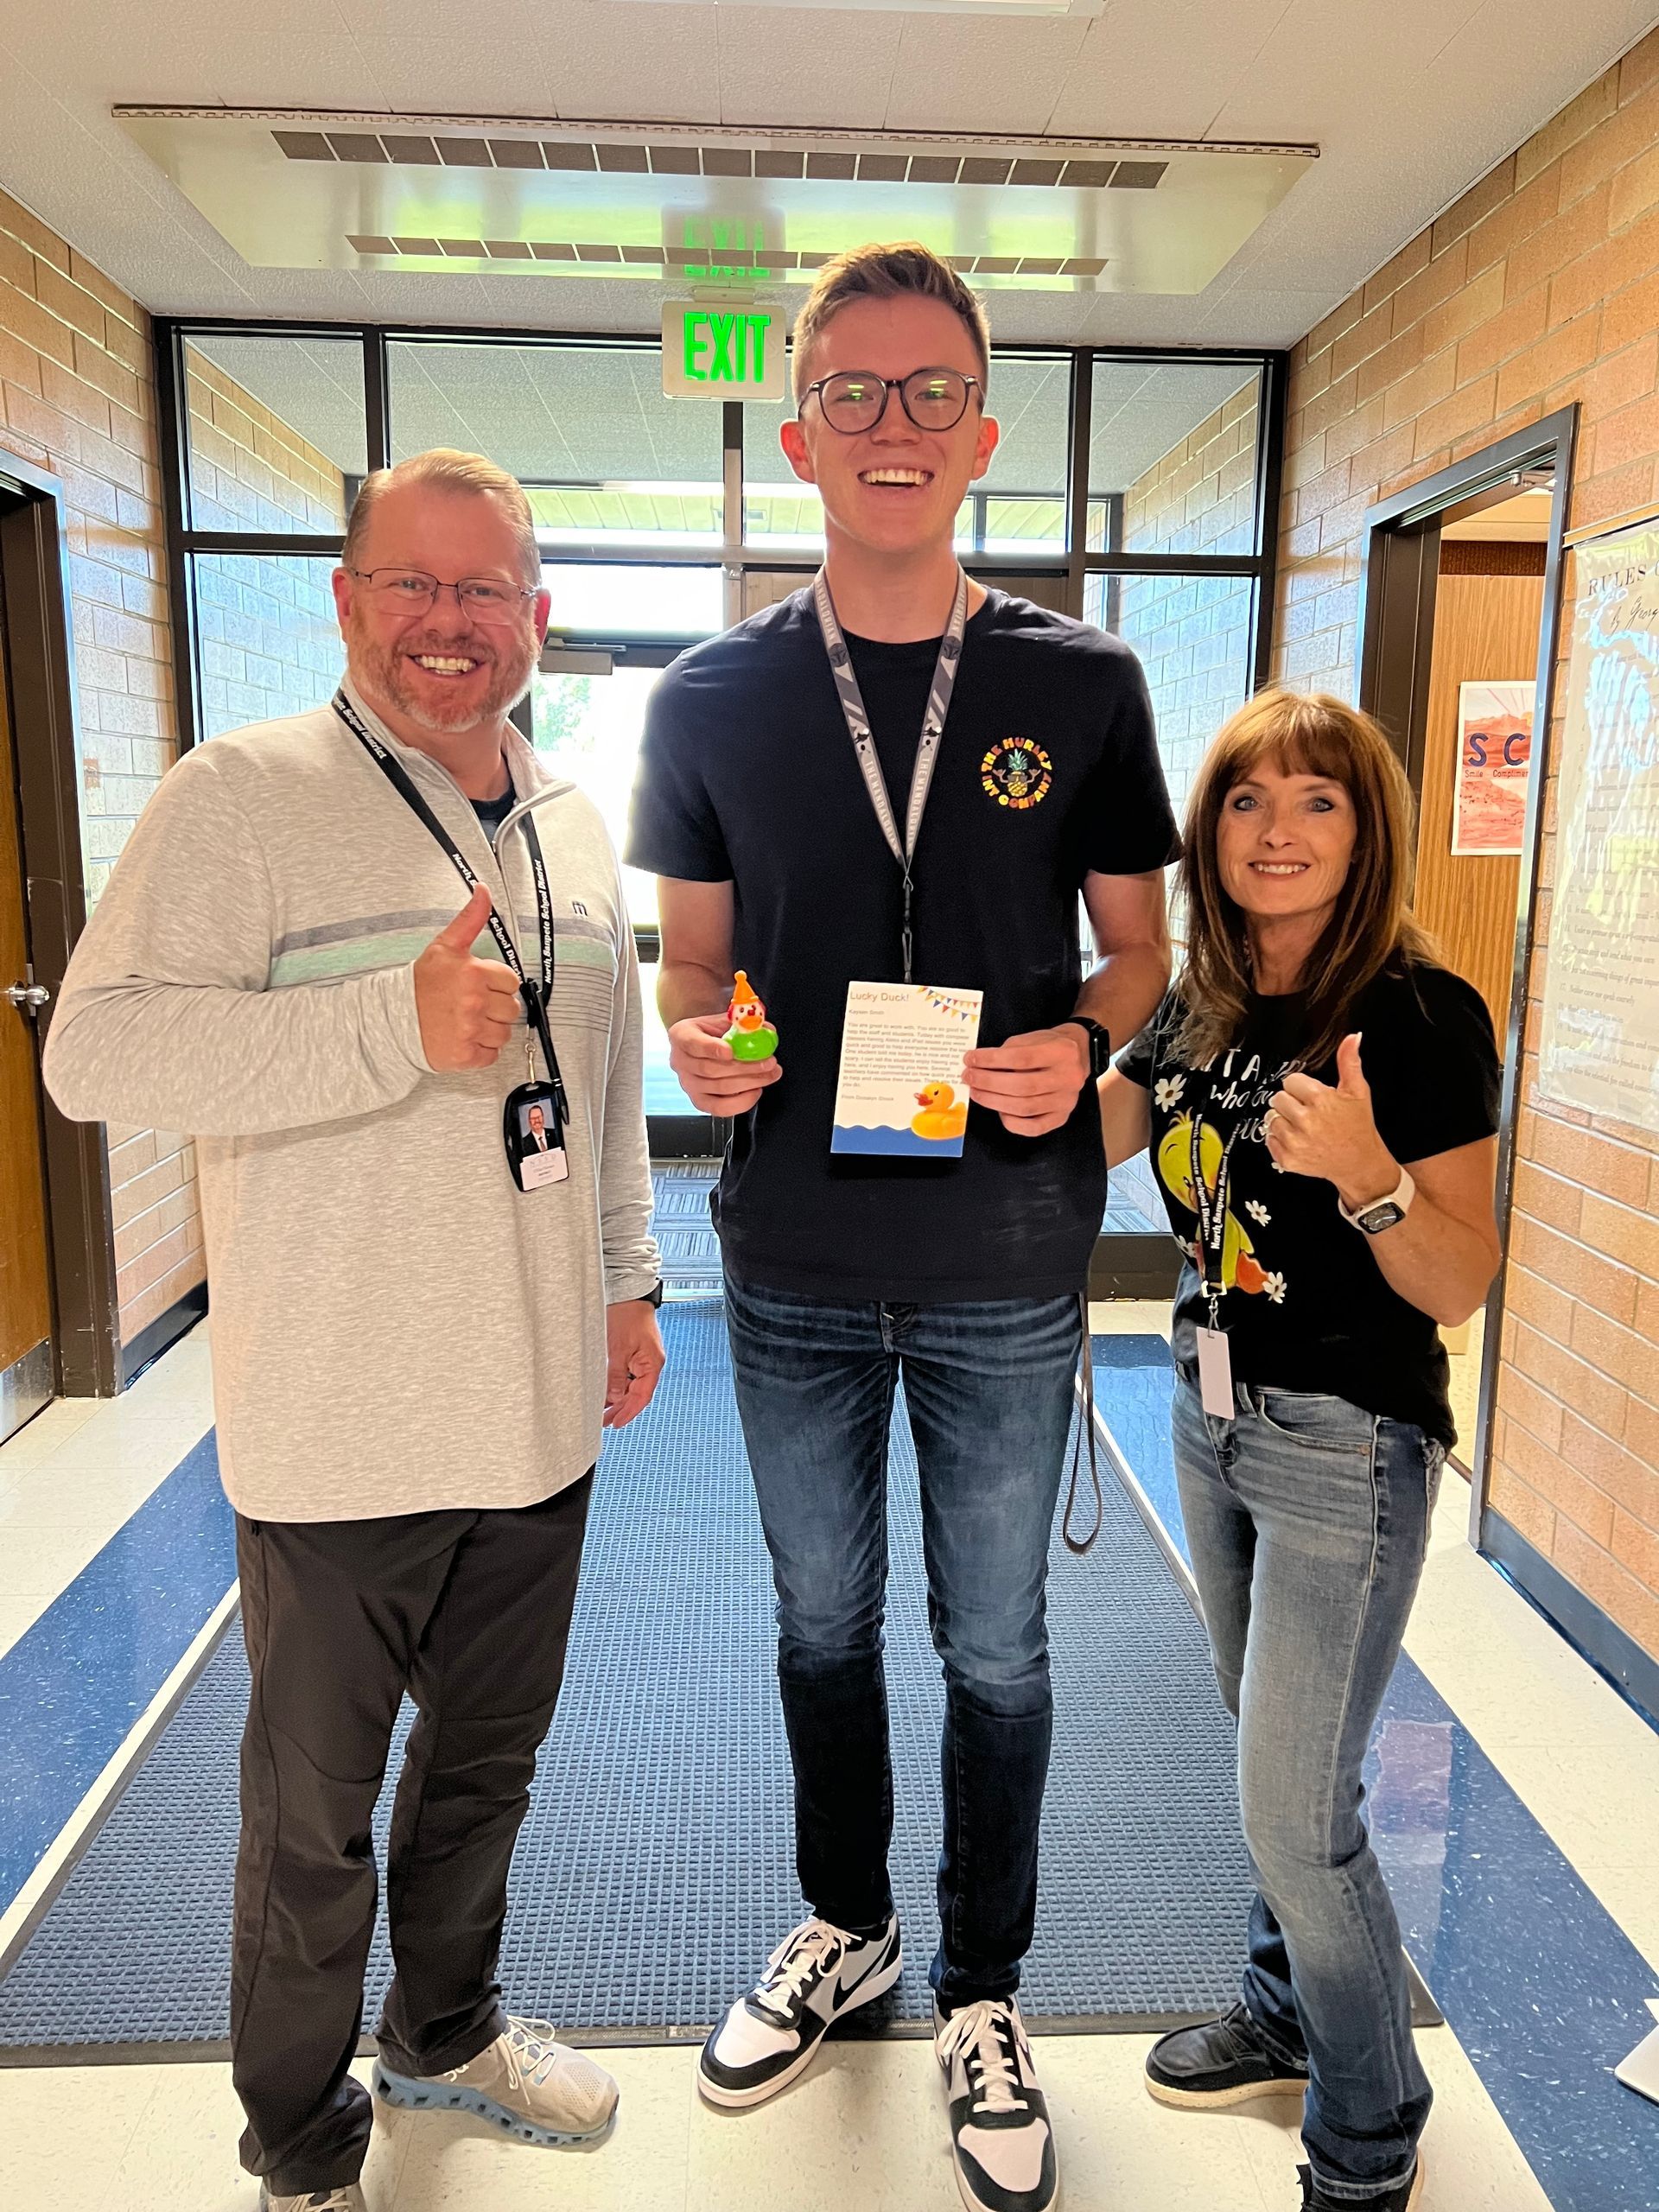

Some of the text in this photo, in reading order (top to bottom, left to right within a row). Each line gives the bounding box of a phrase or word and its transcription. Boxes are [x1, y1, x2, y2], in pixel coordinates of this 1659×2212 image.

[683, 312, 771, 383] EXIT
[1588, 563, 1647, 596] RULES
[918, 759, 930, 775] THE
[982, 737, 1052, 772] THE HURLEY
[998, 772, 1052, 809] COMPANY
[1465, 770, 1483, 779] Smile
[865, 761, 897, 851] THE MANDALORIAN
[453, 854, 474, 883] North
[490, 917, 511, 950] School
[534, 860, 553, 984] North Sanpete School District
[850, 991, 909, 1002] Lucky Duck!
[1241, 1055, 1261, 1082] A
[1210, 1081, 1250, 1109] who
[1218, 1155, 1229, 1187] School
[1195, 1176, 1210, 1207] School
[1212, 1187, 1224, 1224] Sanpete
[1211, 1224, 1224, 1249] North
